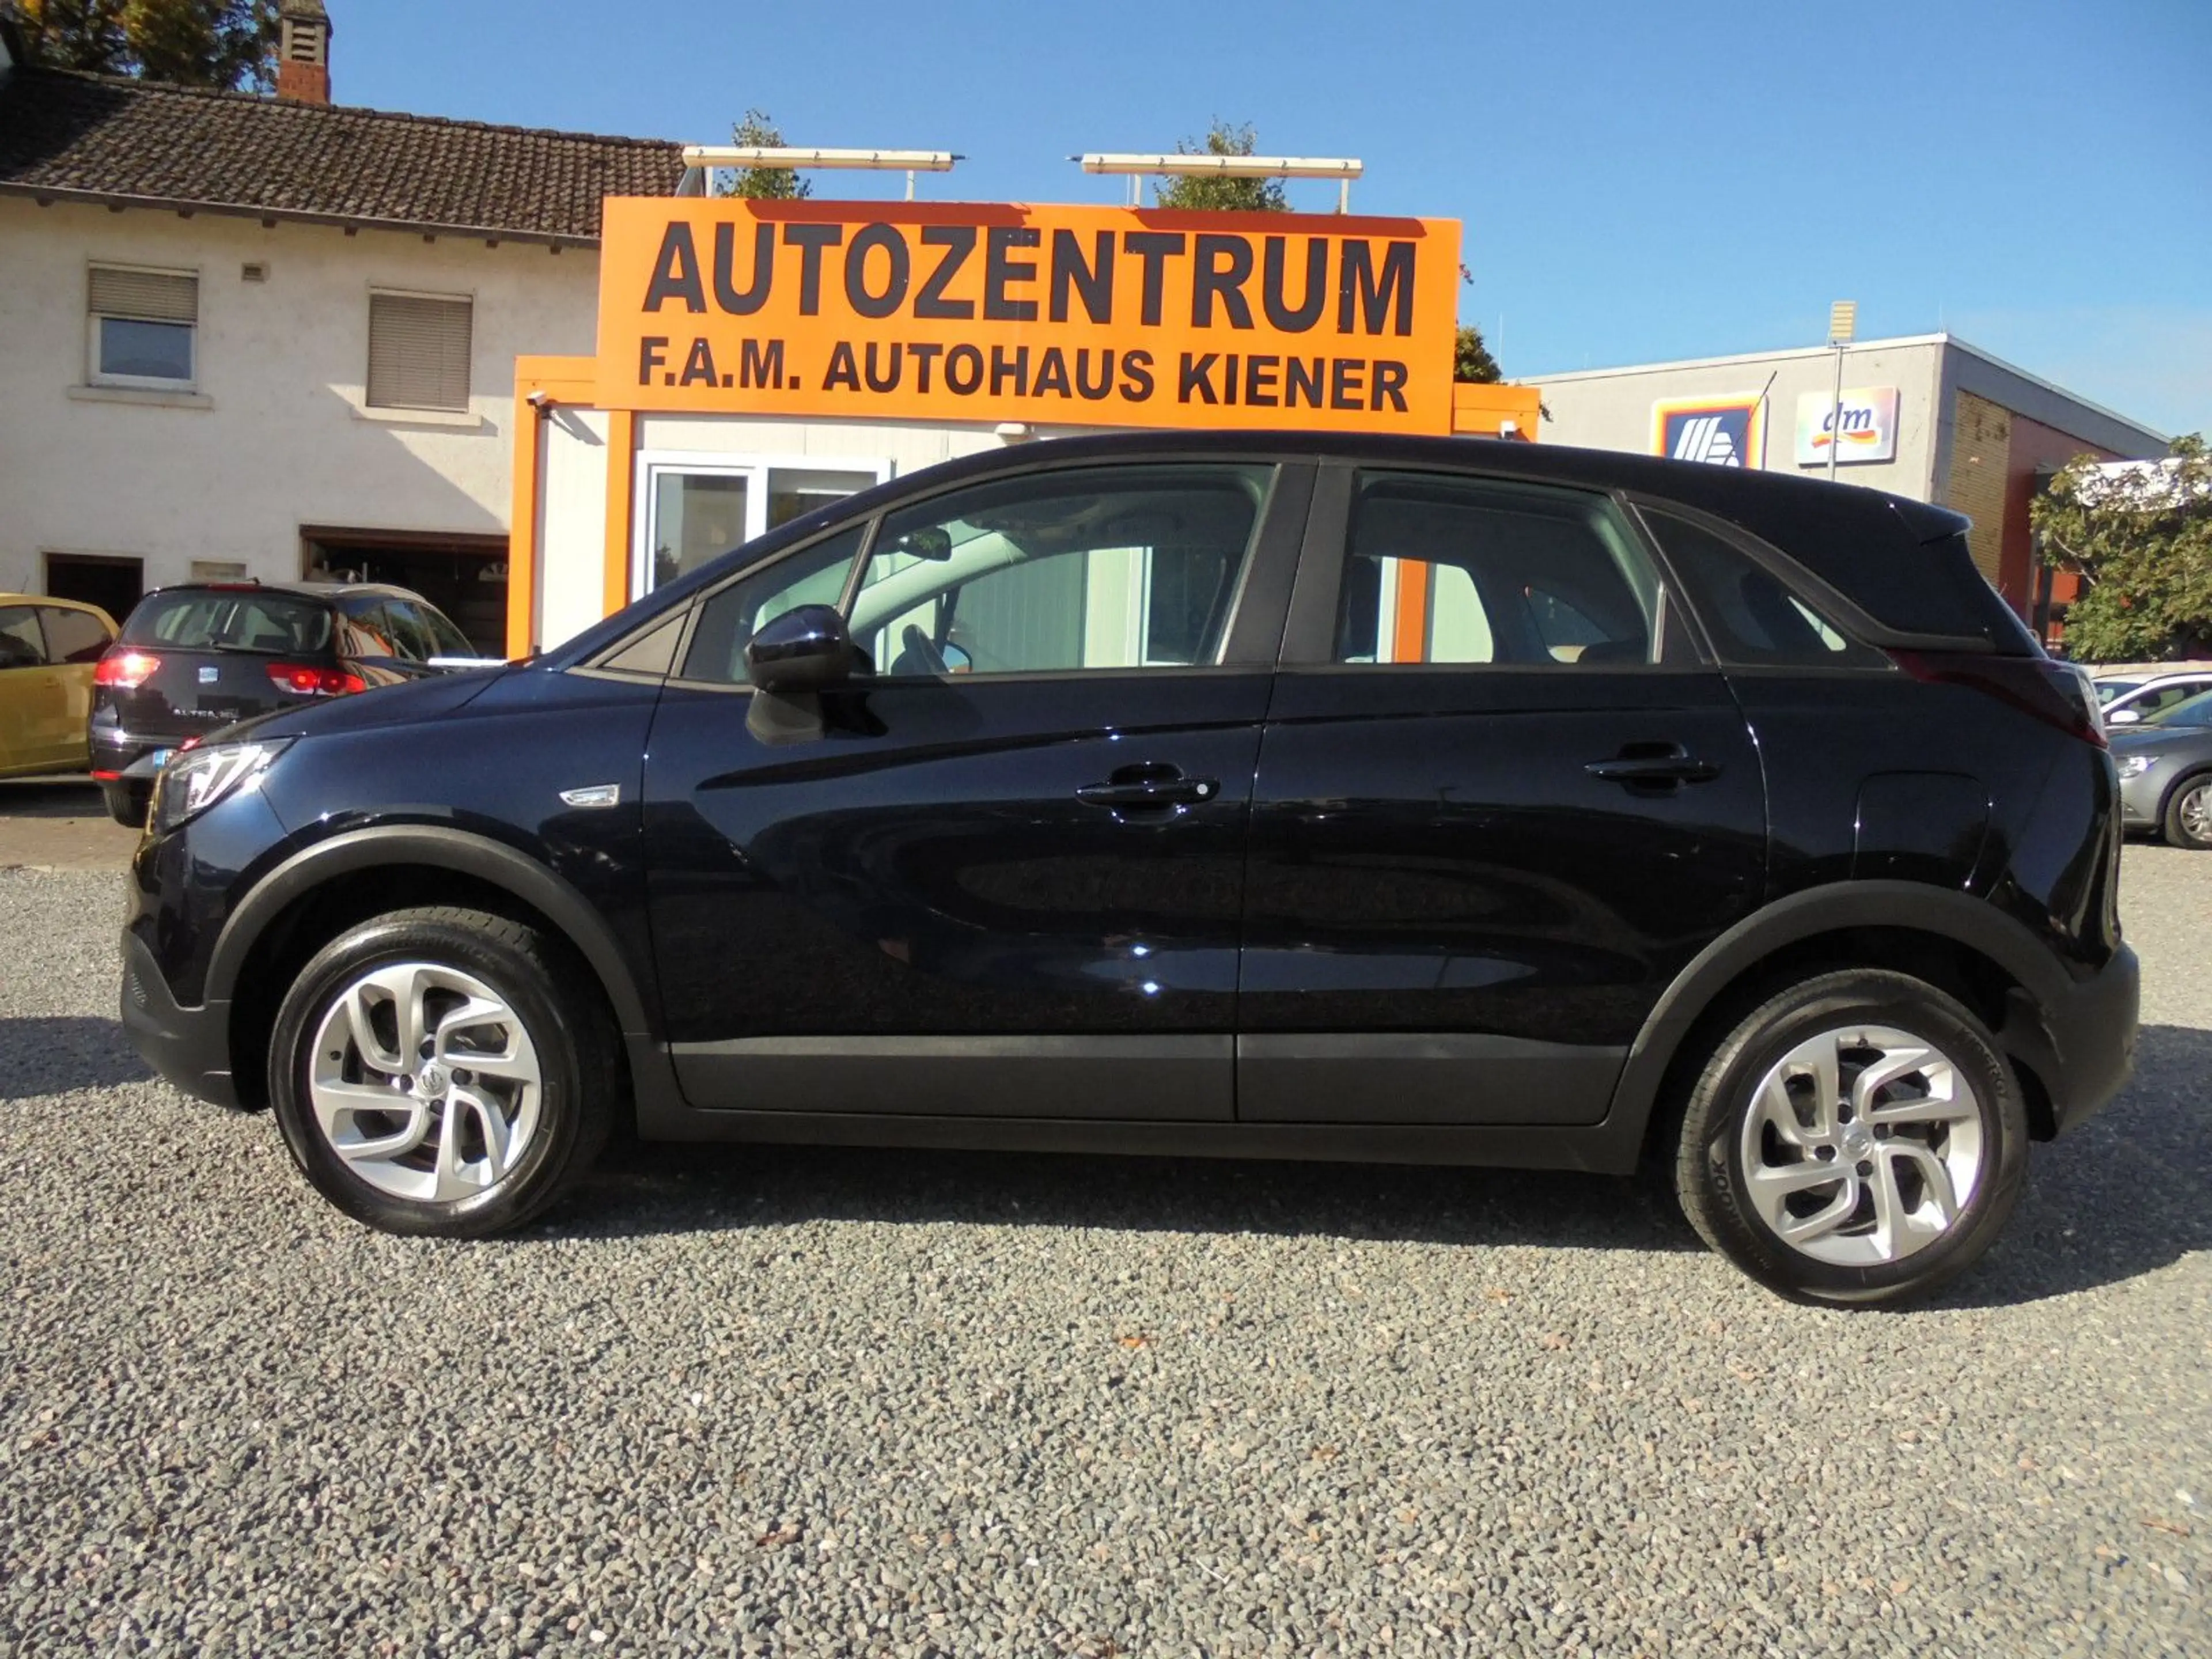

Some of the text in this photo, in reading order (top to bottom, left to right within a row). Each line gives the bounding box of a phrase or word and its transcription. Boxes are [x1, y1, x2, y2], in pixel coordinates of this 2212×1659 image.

[642, 221, 1416, 336] AUTOZENTRUM
[639, 337, 1409, 413] F.A.M. AUTOHAUS KIENER
[1823, 402, 1872, 431] dm
